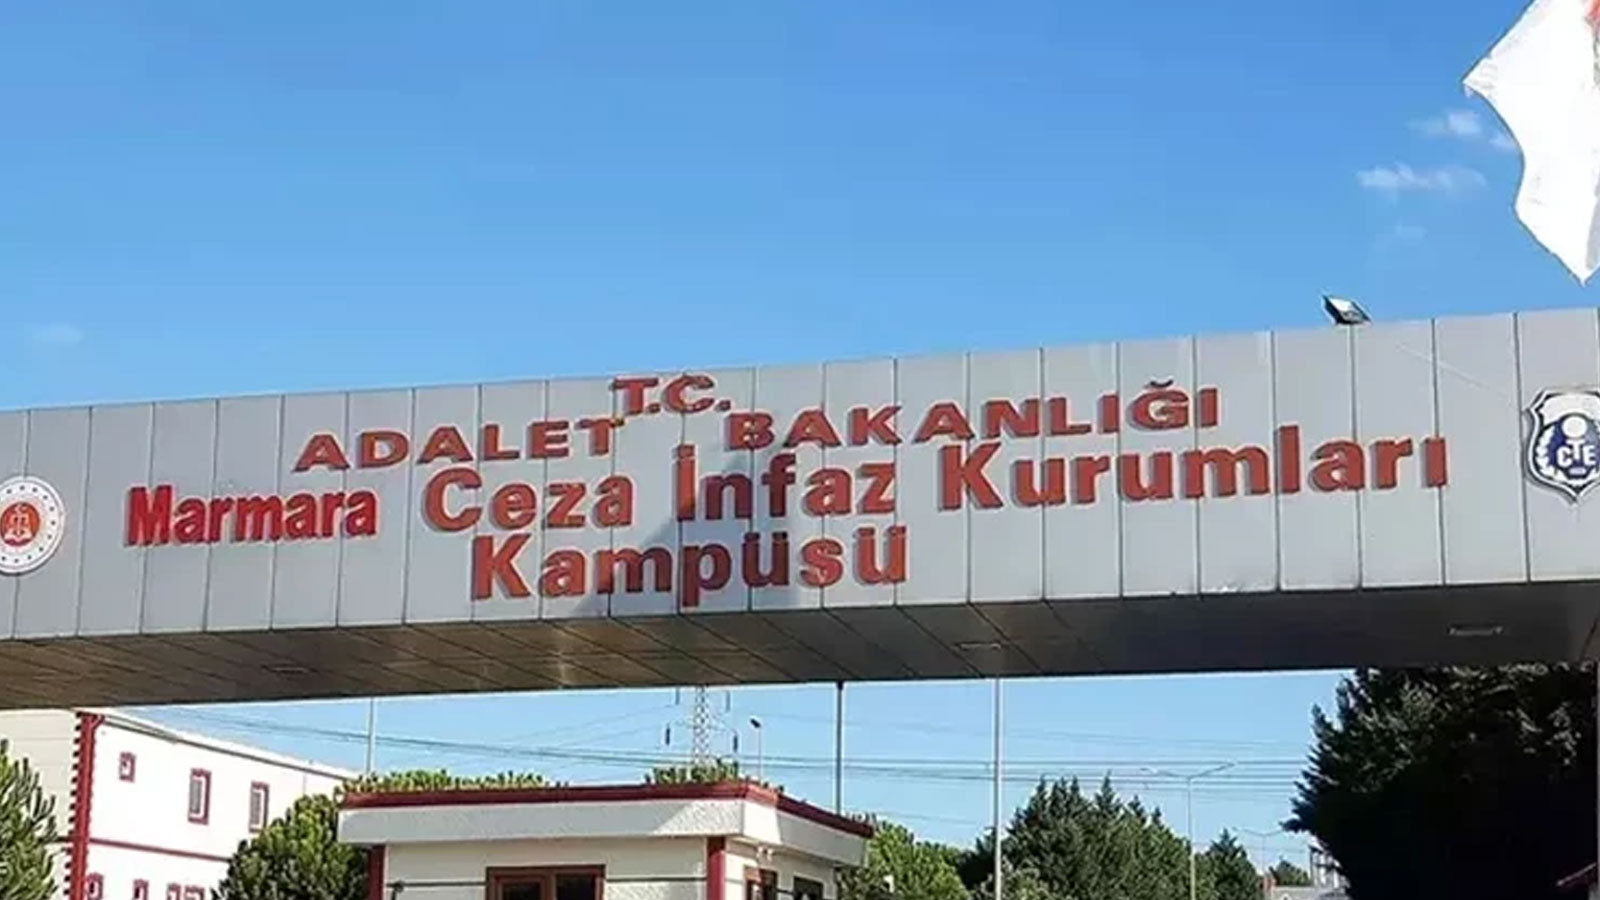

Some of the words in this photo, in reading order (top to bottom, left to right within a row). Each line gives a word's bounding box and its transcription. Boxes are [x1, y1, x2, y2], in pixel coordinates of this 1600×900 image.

[295, 417, 624, 472] ADALET
[727, 380, 1220, 450] BAKANLIĞI
[613, 376, 731, 415] T.C.
[125, 484, 379, 547] Marmara
[424, 465, 637, 532] Ceza
[676, 444, 897, 521] İnfaz
[938, 424, 1449, 511] Kurumları
[1556, 439, 1598, 468] CTE
[471, 524, 908, 607] Kampüsü
